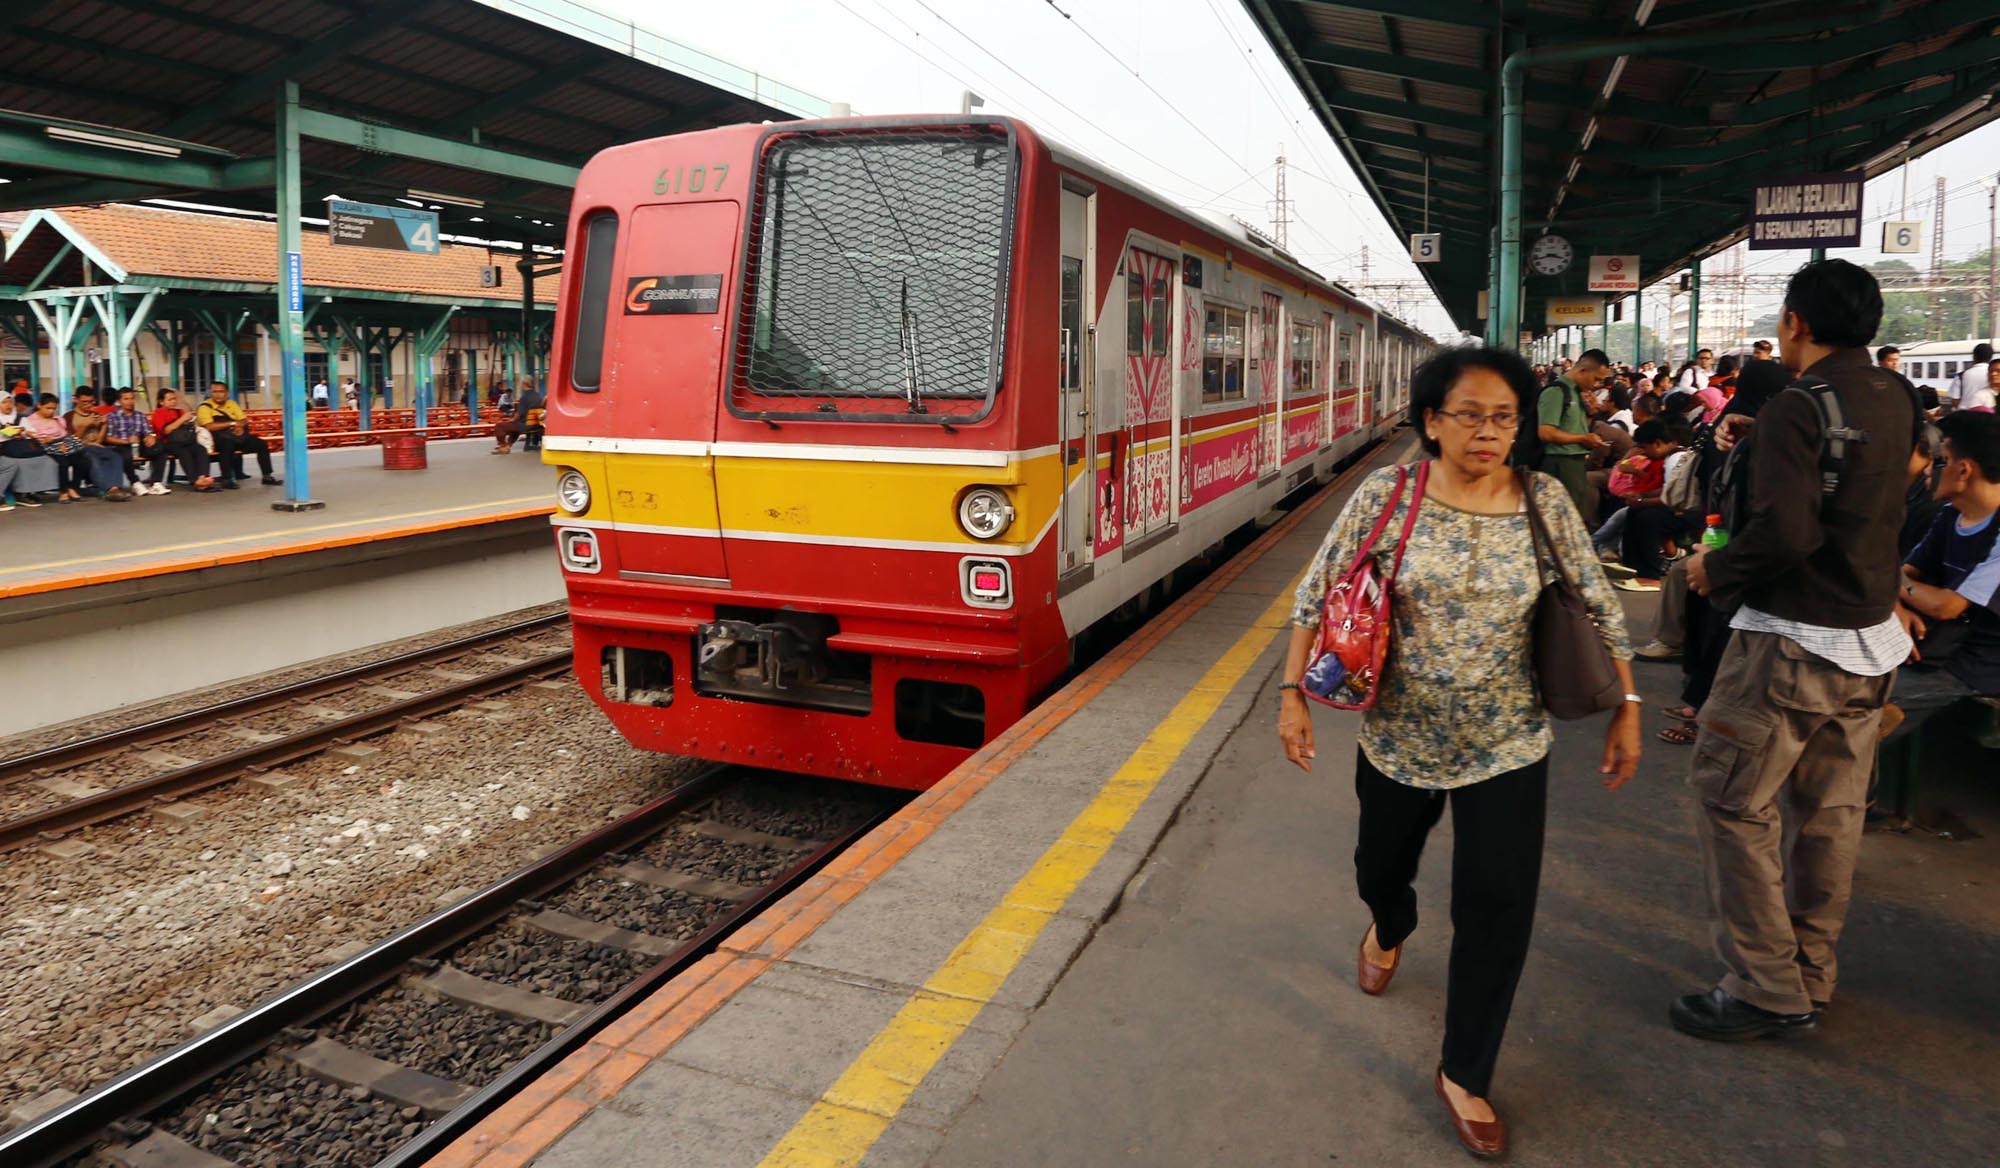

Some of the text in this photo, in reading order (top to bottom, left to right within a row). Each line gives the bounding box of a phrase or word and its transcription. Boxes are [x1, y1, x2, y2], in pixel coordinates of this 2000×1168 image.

[653, 163, 730, 195] 6107
[1755, 182, 1859, 215] DILARANG BERJUALAN
[411, 222, 436, 252] 4
[1754, 222, 1764, 240] DI
[1765, 219, 1813, 239] SEPANJANG
[1814, 218, 1843, 238] PERON
[1897, 227, 1911, 246] 6
[1420, 239, 1433, 256] 5
[484, 270, 492, 283] 3
[642, 288, 719, 301] COMMUTER
[1555, 306, 1594, 314] KELUAR
